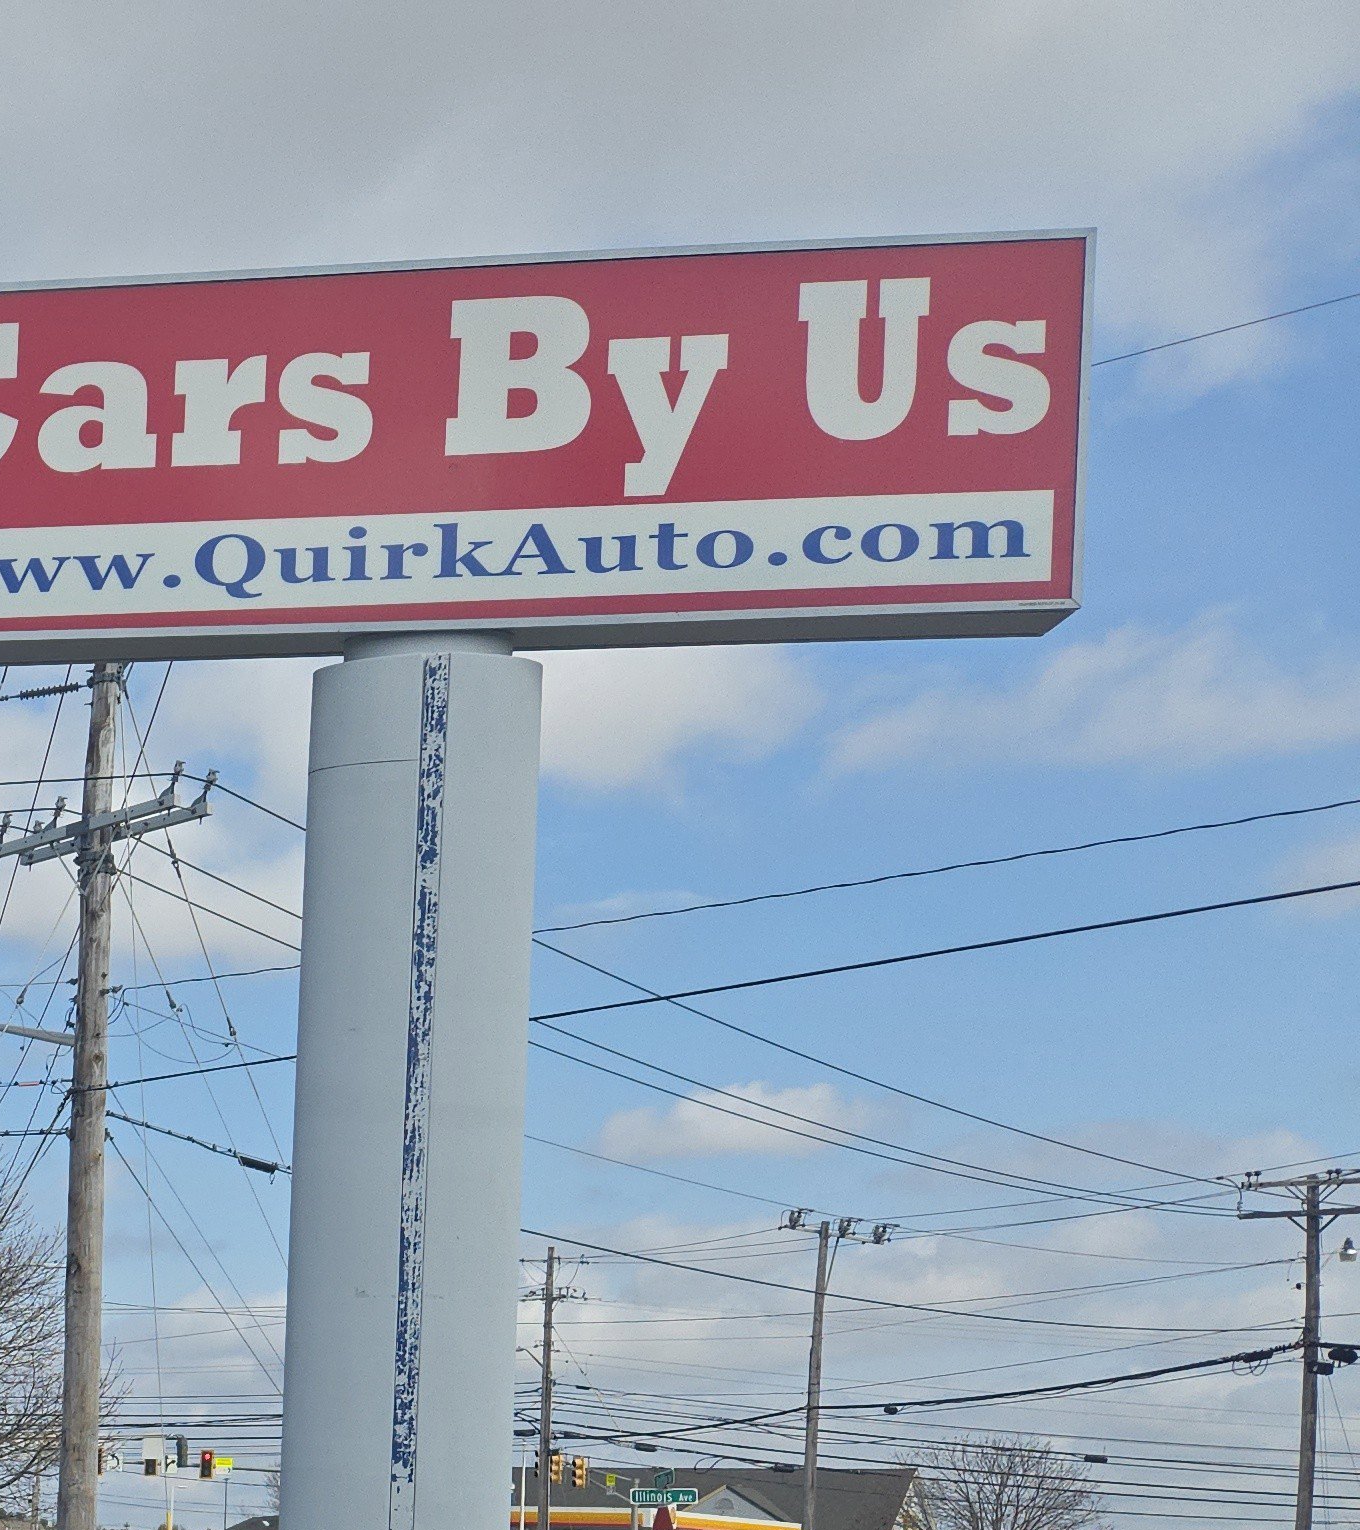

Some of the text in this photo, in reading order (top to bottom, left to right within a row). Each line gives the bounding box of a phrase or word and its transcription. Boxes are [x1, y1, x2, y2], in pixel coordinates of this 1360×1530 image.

[445, 295, 729, 498] By
[798, 276, 1051, 442] Us
[635, 1490, 693, 1503] Illinois Ave
